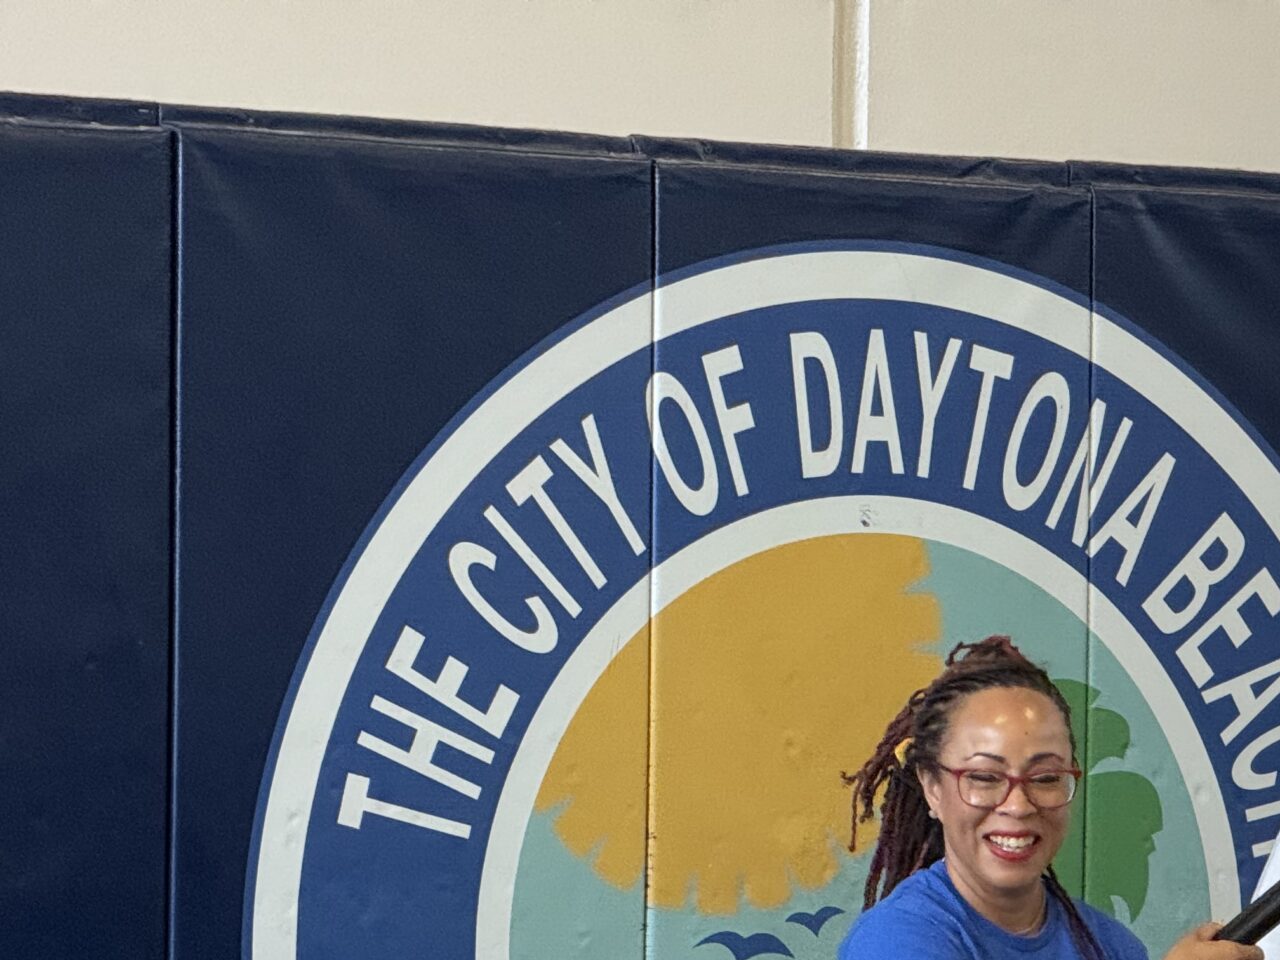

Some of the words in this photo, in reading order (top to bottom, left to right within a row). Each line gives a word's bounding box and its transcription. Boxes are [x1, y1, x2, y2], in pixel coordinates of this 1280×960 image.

[337, 625, 520, 839] THE
[448, 414, 646, 654] CITY
[645, 345, 755, 516] OF
[790, 329, 1176, 587] DAYTONA
